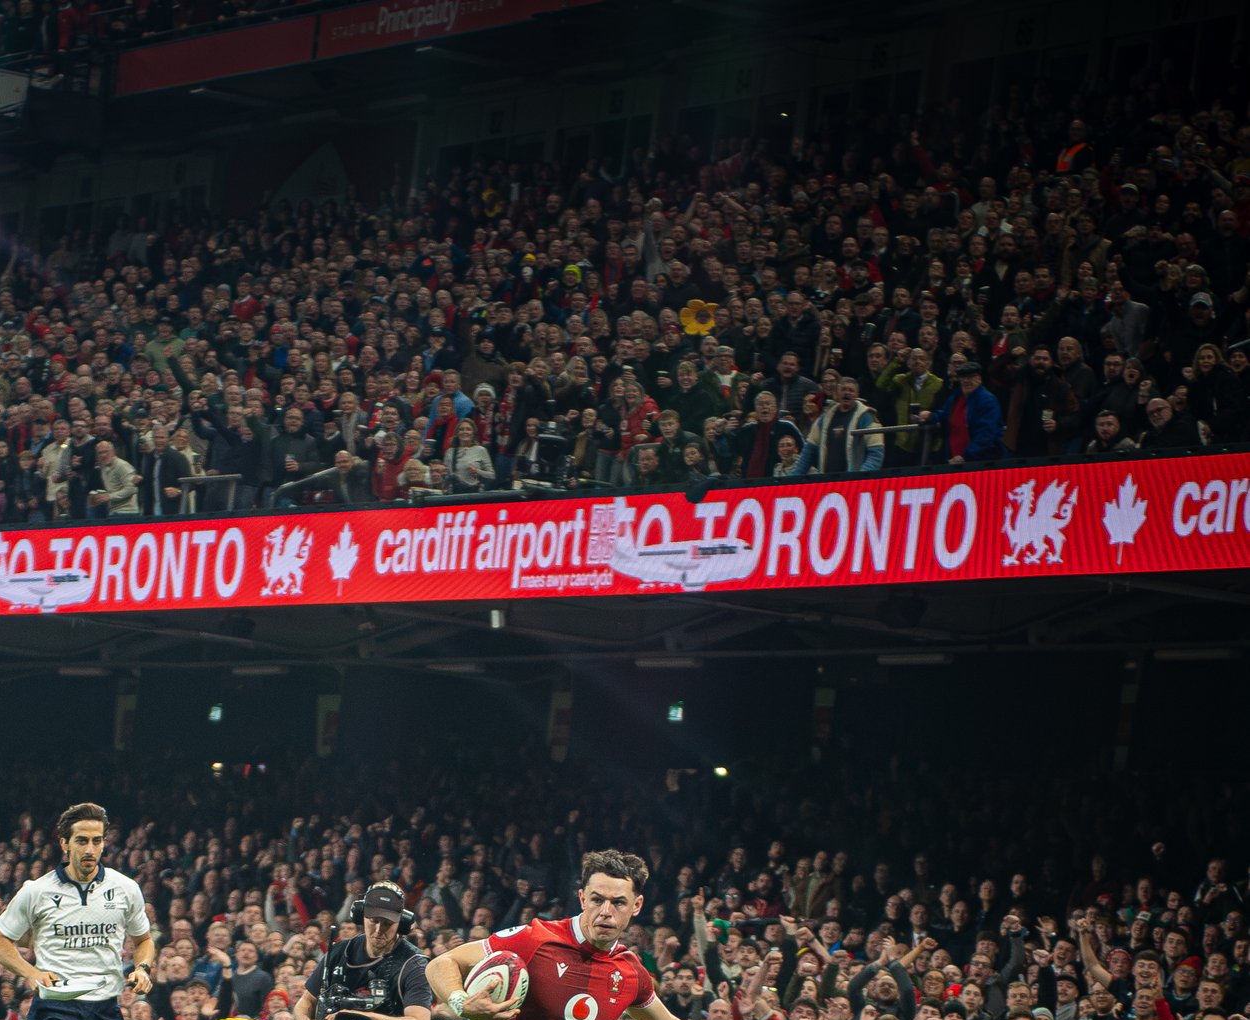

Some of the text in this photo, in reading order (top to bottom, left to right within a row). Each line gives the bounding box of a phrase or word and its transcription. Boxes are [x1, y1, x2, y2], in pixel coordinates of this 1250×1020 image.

[376, 0, 459, 36] Principality
[1173, 478, 1250, 537] car
[374, 510, 477, 575] cardiff
[475, 509, 585, 589] airport
[695, 484, 978, 577] TORONTO
[48, 526, 245, 603] TORONTO
[53, 921, 117, 937] Emirates
[63, 937, 79, 949] FLY
[333, 966, 343, 975] 21
